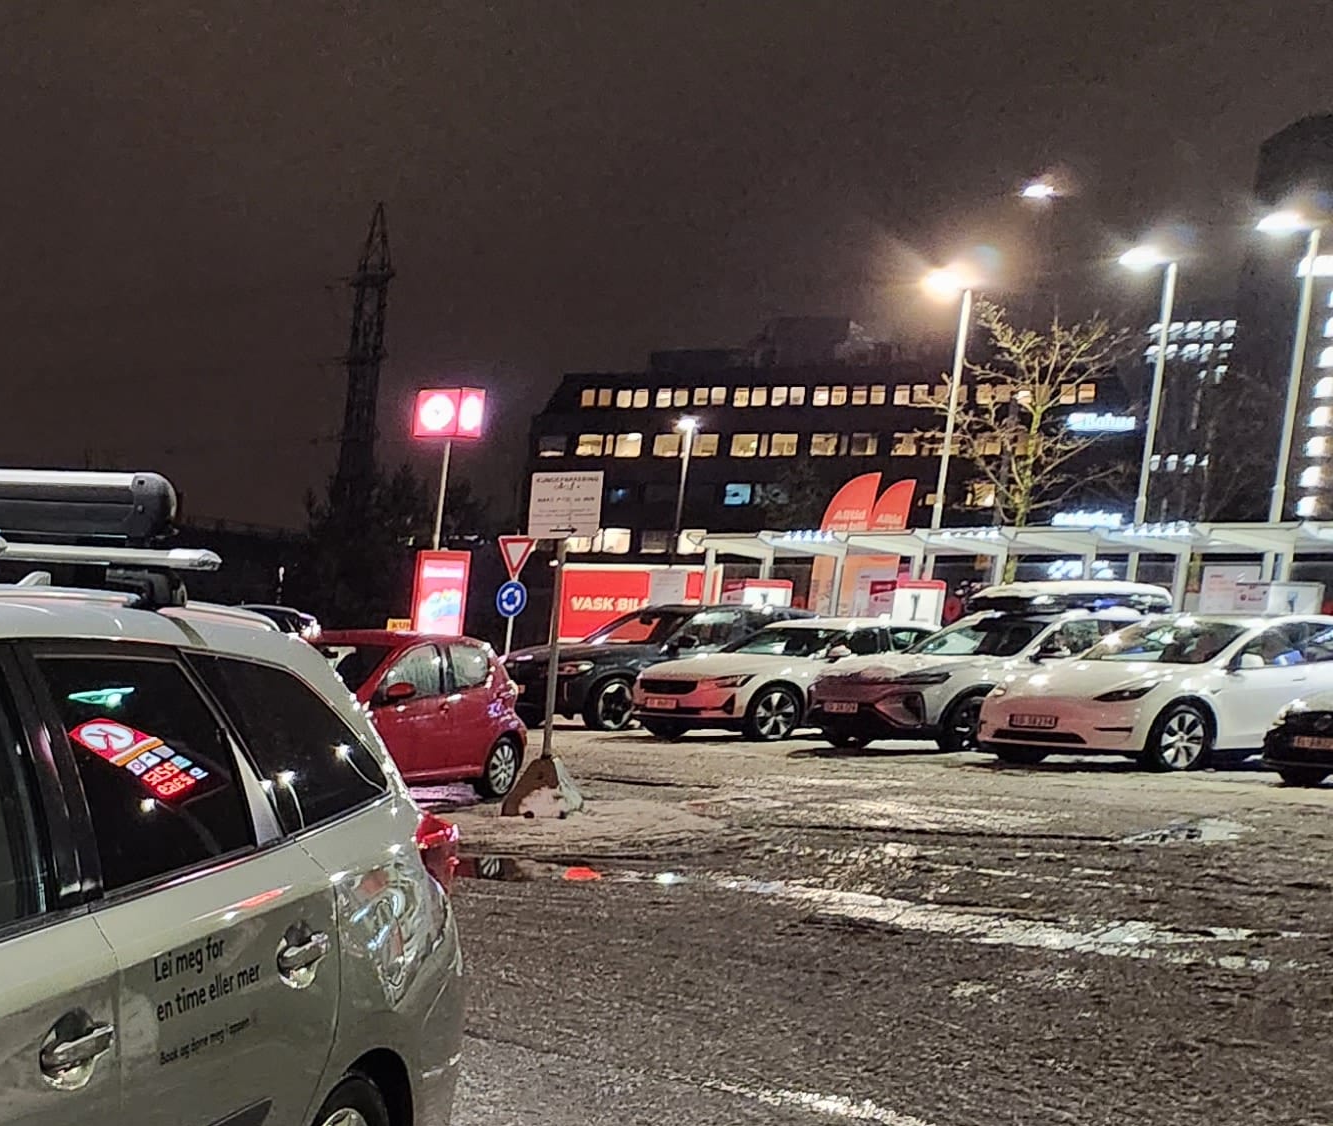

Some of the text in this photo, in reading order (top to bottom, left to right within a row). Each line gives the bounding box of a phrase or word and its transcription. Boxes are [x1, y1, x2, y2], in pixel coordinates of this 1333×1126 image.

[571, 596, 614, 612] VASK
[154, 936, 225, 982] Lei meg for
[156, 963, 260, 1021] en time eller mer
